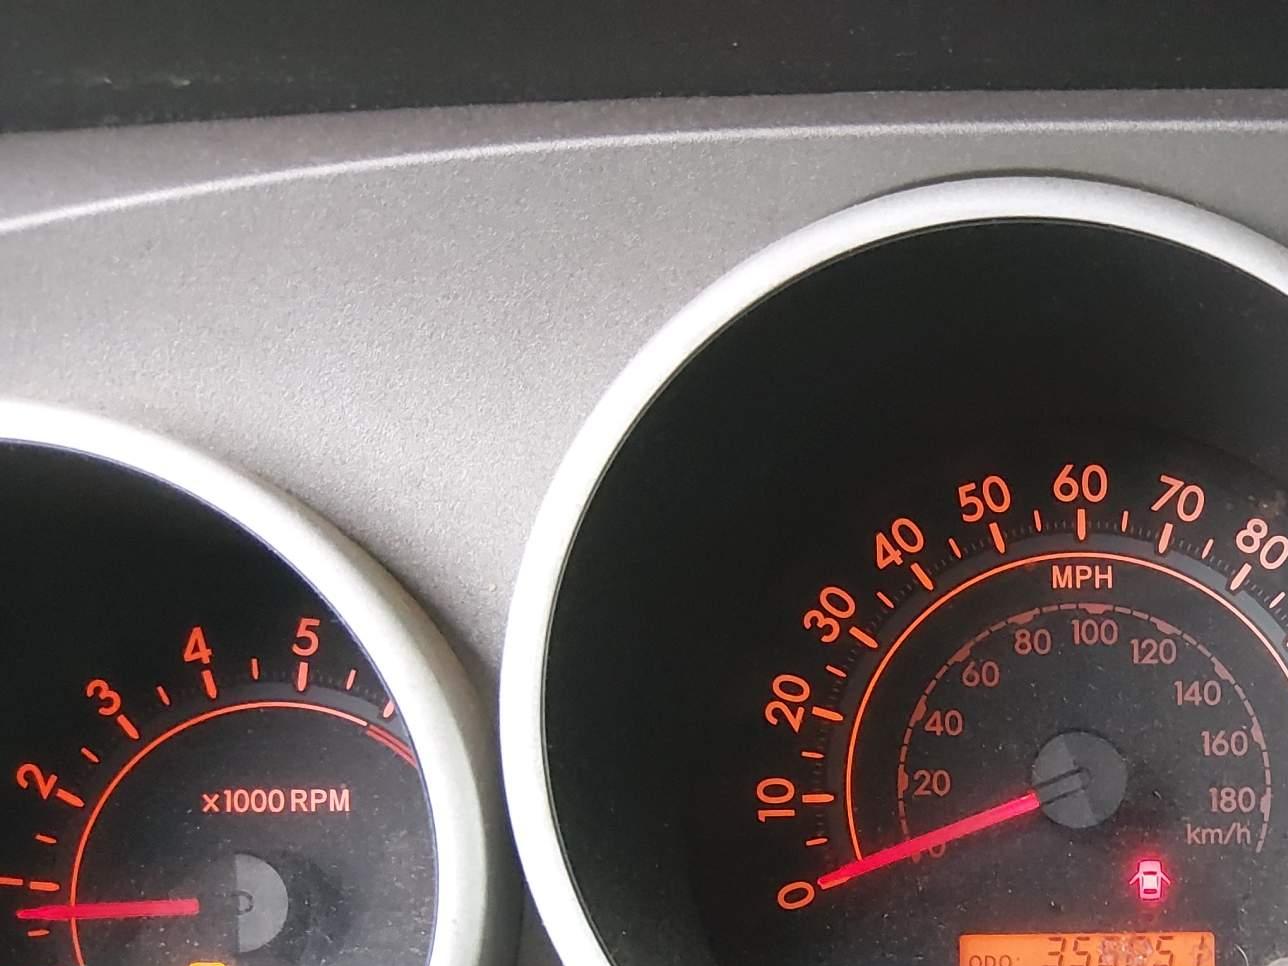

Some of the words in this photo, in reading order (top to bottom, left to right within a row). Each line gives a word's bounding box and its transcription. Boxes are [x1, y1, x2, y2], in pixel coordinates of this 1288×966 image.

[1053, 464, 1108, 503] 60
[958, 475, 1011, 523] 50
[1151, 475, 1205, 522] 70
[875, 517, 925, 570] 40
[1052, 565, 1113, 589] MPH
[803, 586, 857, 643] 30
[183, 626, 213, 665] 4
[291, 617, 321, 657] 5
[1014, 628, 1052, 656] 80
[1071, 618, 1119, 645] 100
[1130, 638, 1177, 665] 120
[961, 661, 1000, 687] 60
[86, 679, 121, 717] 3
[764, 674, 811, 733] 20
[1174, 680, 1222, 706] 140
[924, 709, 963, 736] 40
[1201, 730, 1249, 757] 160
[15, 763, 58, 800] 2
[913, 769, 951, 797] 20
[290, 788, 350, 812] RPM
[756, 777, 796, 823] 10
[1209, 786, 1256, 813] 180
[1186, 822, 1251, 845] km/h
[777, 881, 815, 910] 0
